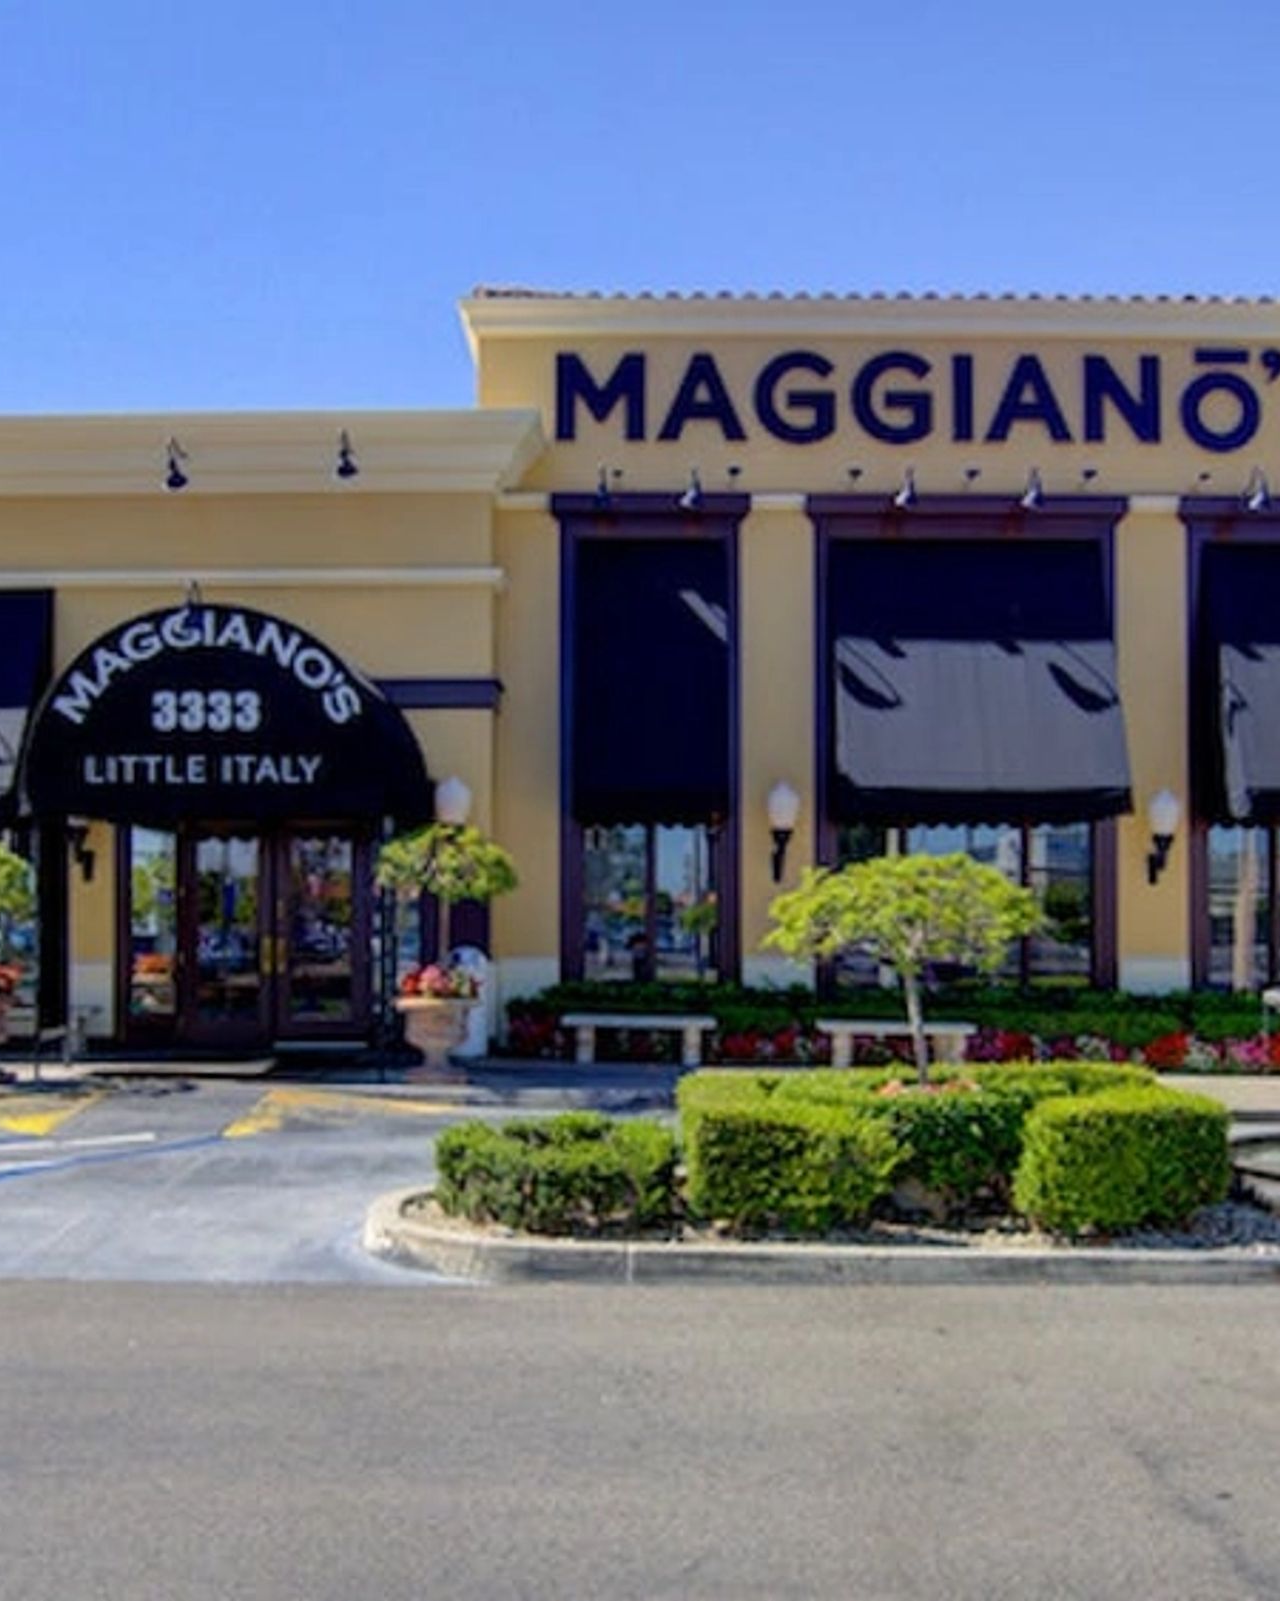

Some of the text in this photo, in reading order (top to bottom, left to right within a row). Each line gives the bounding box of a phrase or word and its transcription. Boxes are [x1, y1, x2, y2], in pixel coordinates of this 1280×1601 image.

[52, 608, 362, 725] MAGGIANO'S
[152, 690, 261, 732] 3333
[84, 755, 321, 784] LITTLE ITALY
